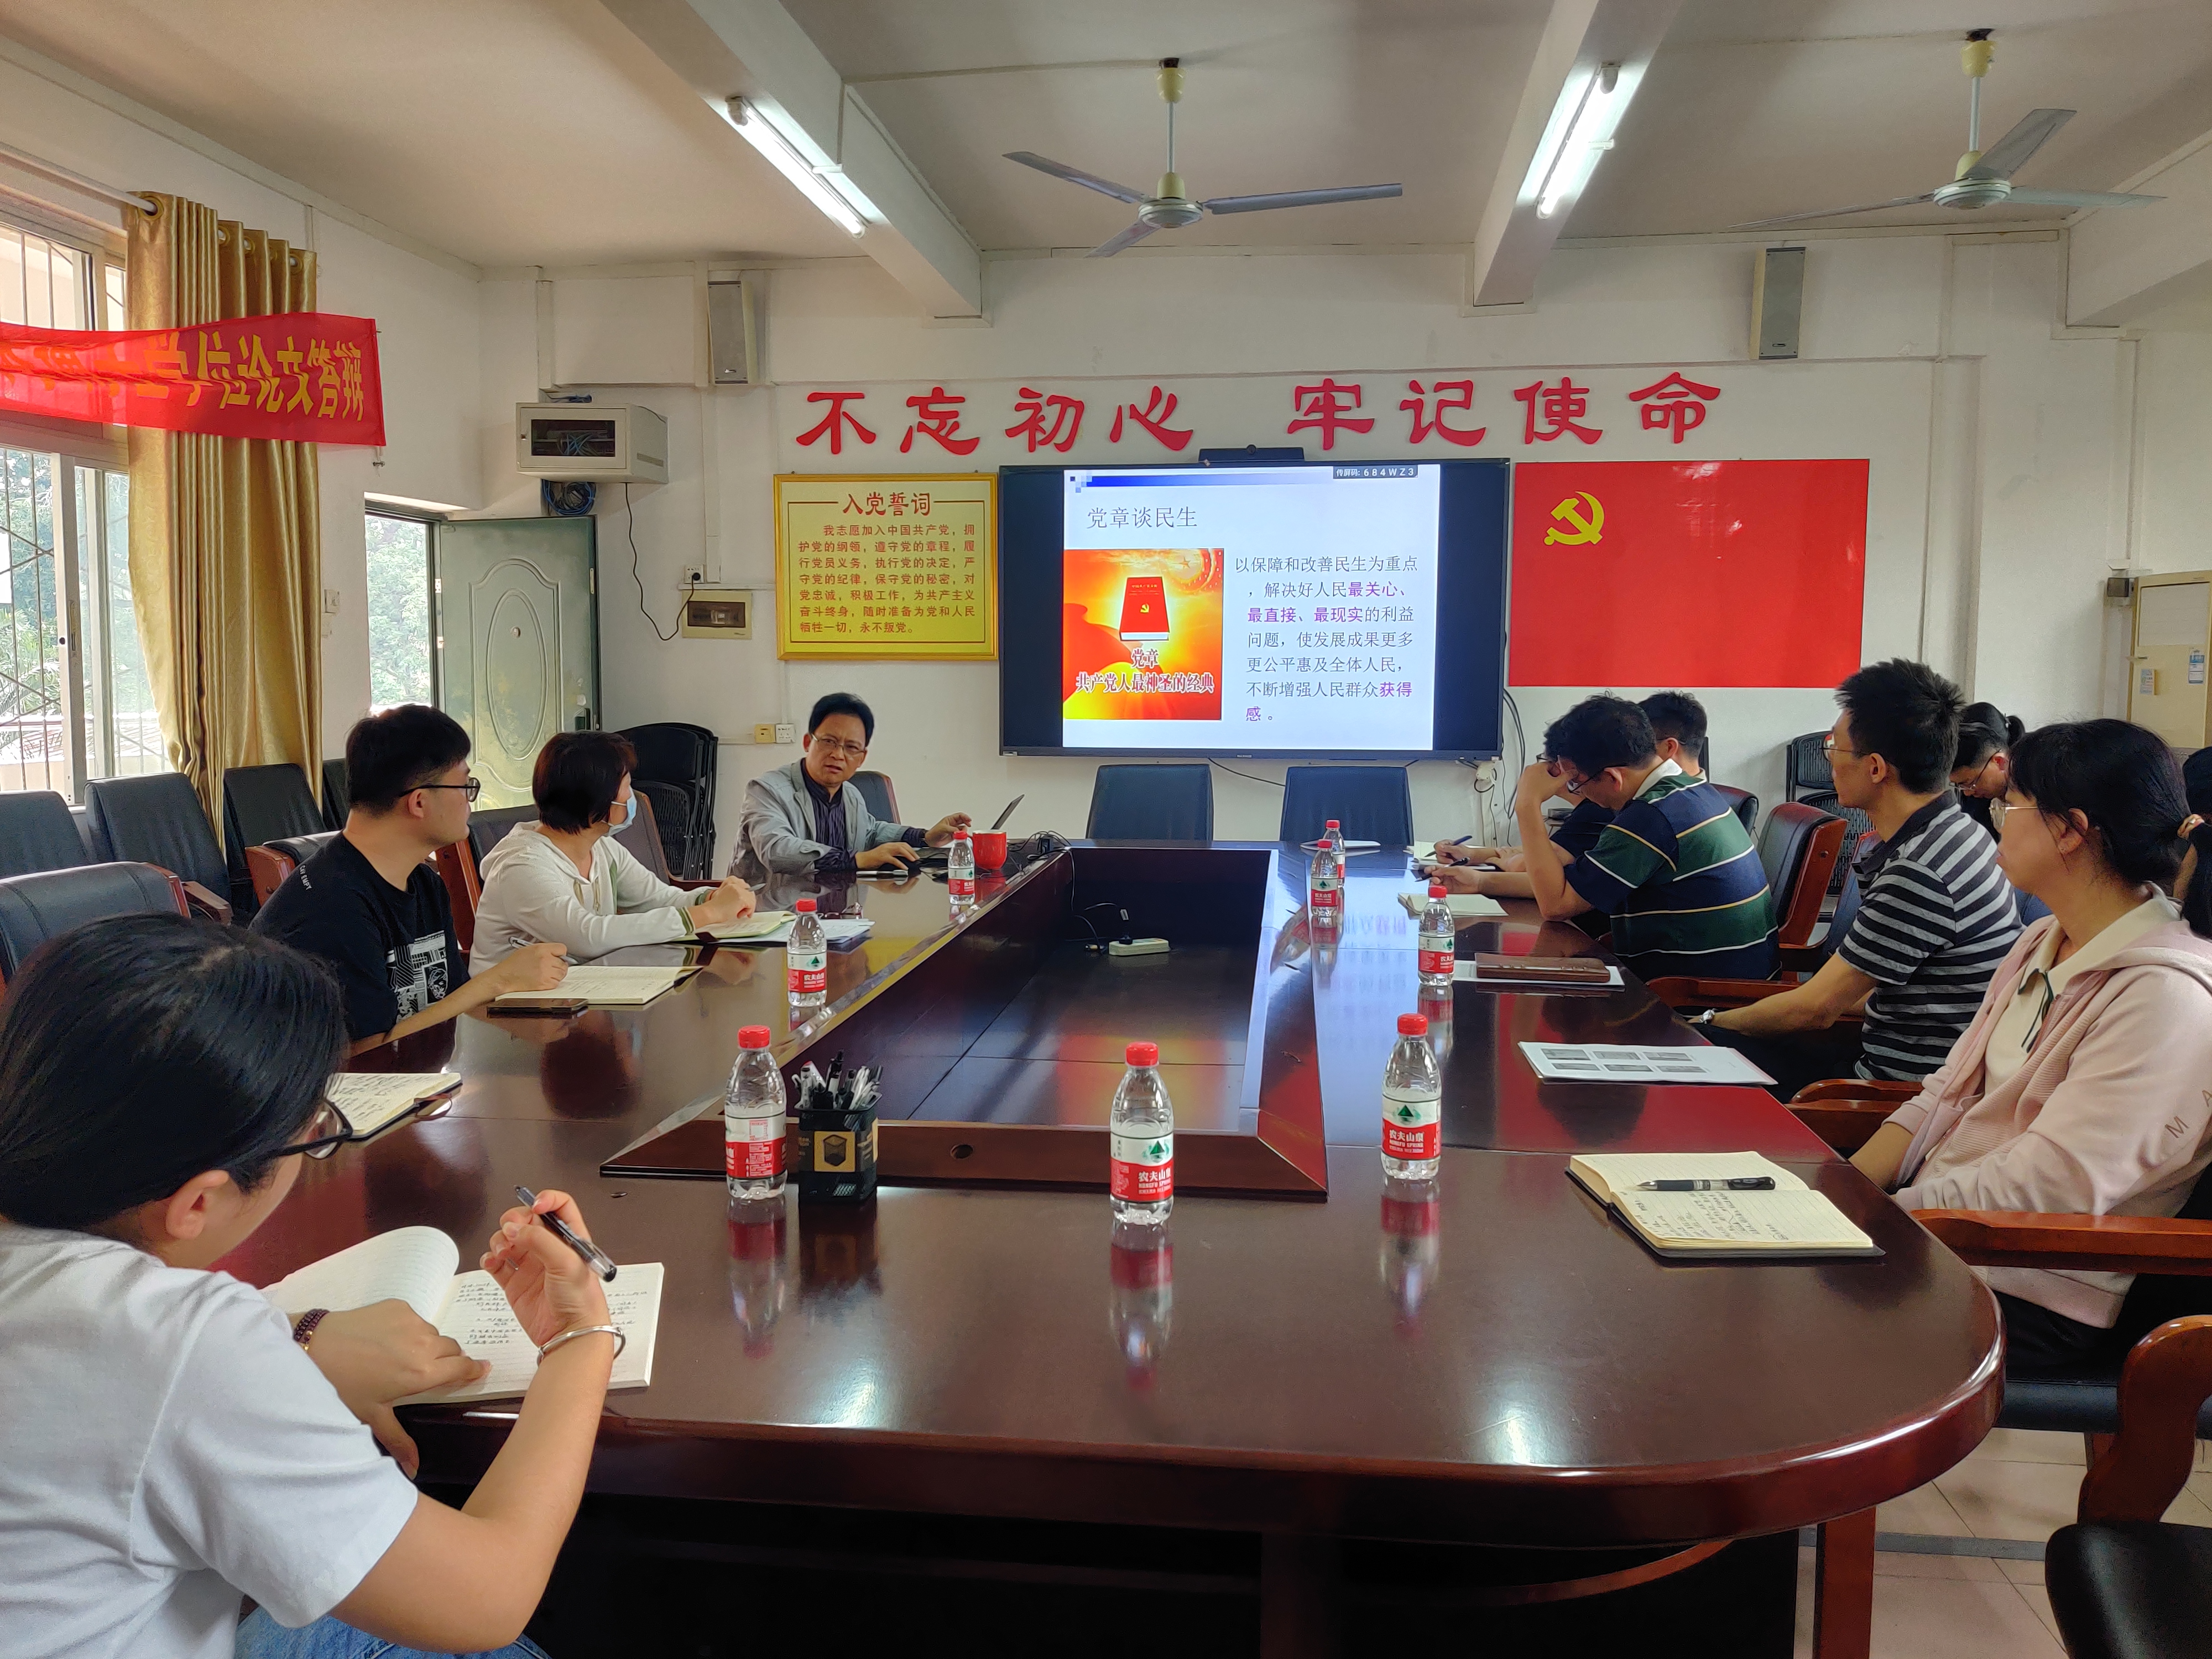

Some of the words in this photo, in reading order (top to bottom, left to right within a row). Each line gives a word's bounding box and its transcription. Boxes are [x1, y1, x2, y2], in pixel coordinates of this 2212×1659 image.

[796, 386, 1193, 455] 不忘初心
[1287, 372, 1721, 451] 牢记使命
[842, 491, 931, 517] 入党誓词
[1086, 507, 1198, 529] 党章谈民生
[1235, 555, 1418, 573] 以保障和改善民生为重点
[1248, 606, 1414, 623] 最直接、最现实的利益
[1248, 631, 1413, 648] 问题，使发展成果更多
[1131, 648, 1159, 669] 党章
[1246, 656, 1402, 673] 更公平惠及全体人民，
[1076, 670, 1215, 694] 共产党人最神圣的经典
[1246, 681, 1413, 698] 不断增强人民群众获得
